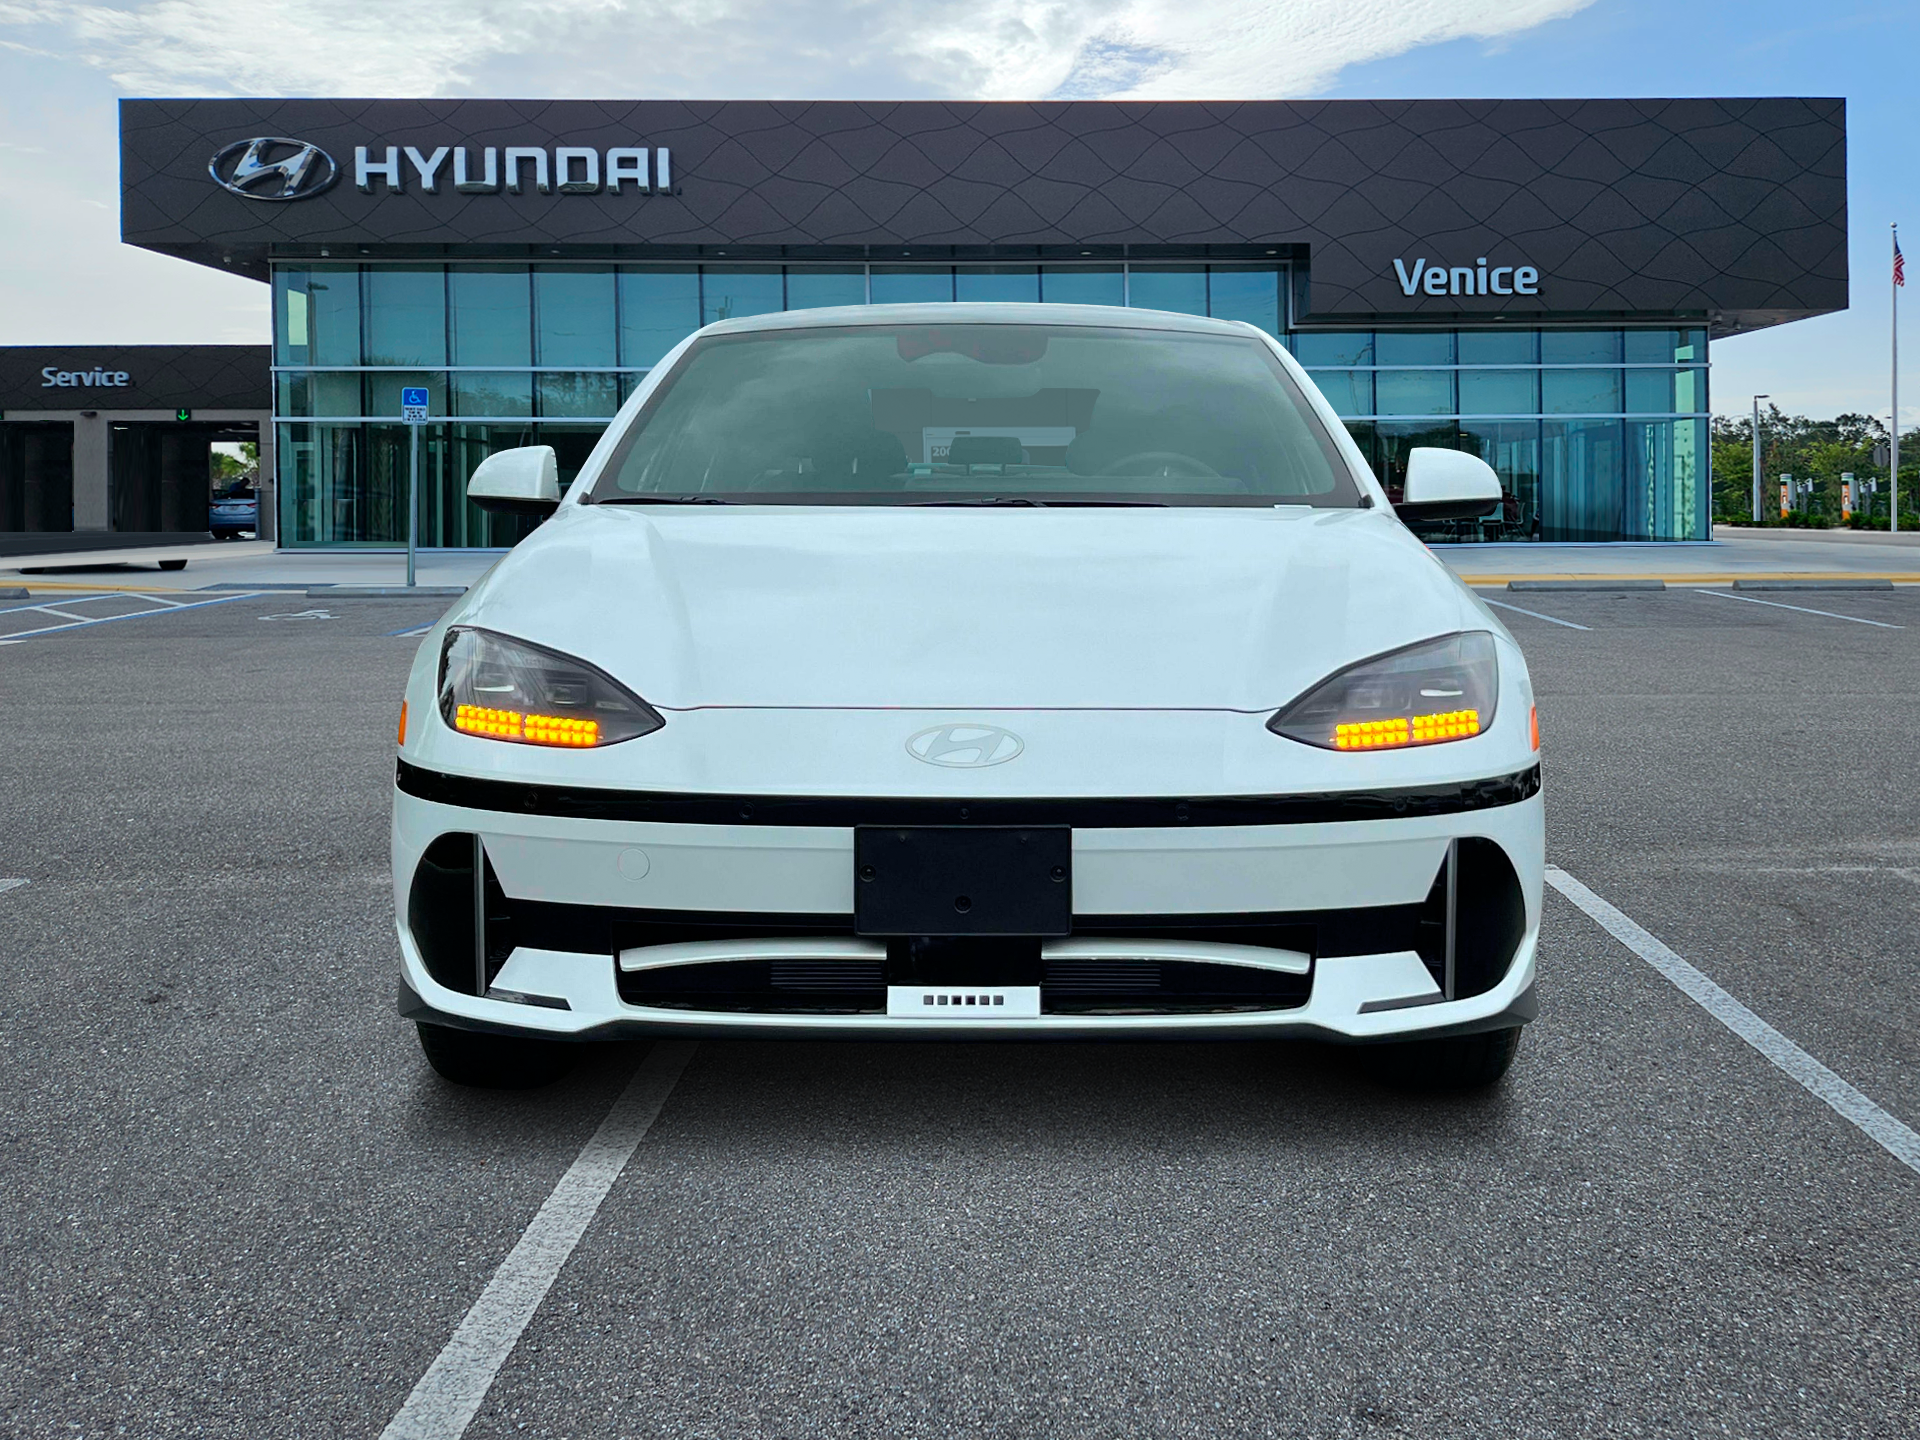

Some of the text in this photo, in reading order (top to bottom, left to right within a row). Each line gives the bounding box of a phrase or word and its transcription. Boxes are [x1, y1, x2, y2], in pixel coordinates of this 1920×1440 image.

[354, 146, 671, 194] HYUNDAI
[1393, 257, 1539, 296] Venice
[41, 366, 130, 387] Service
